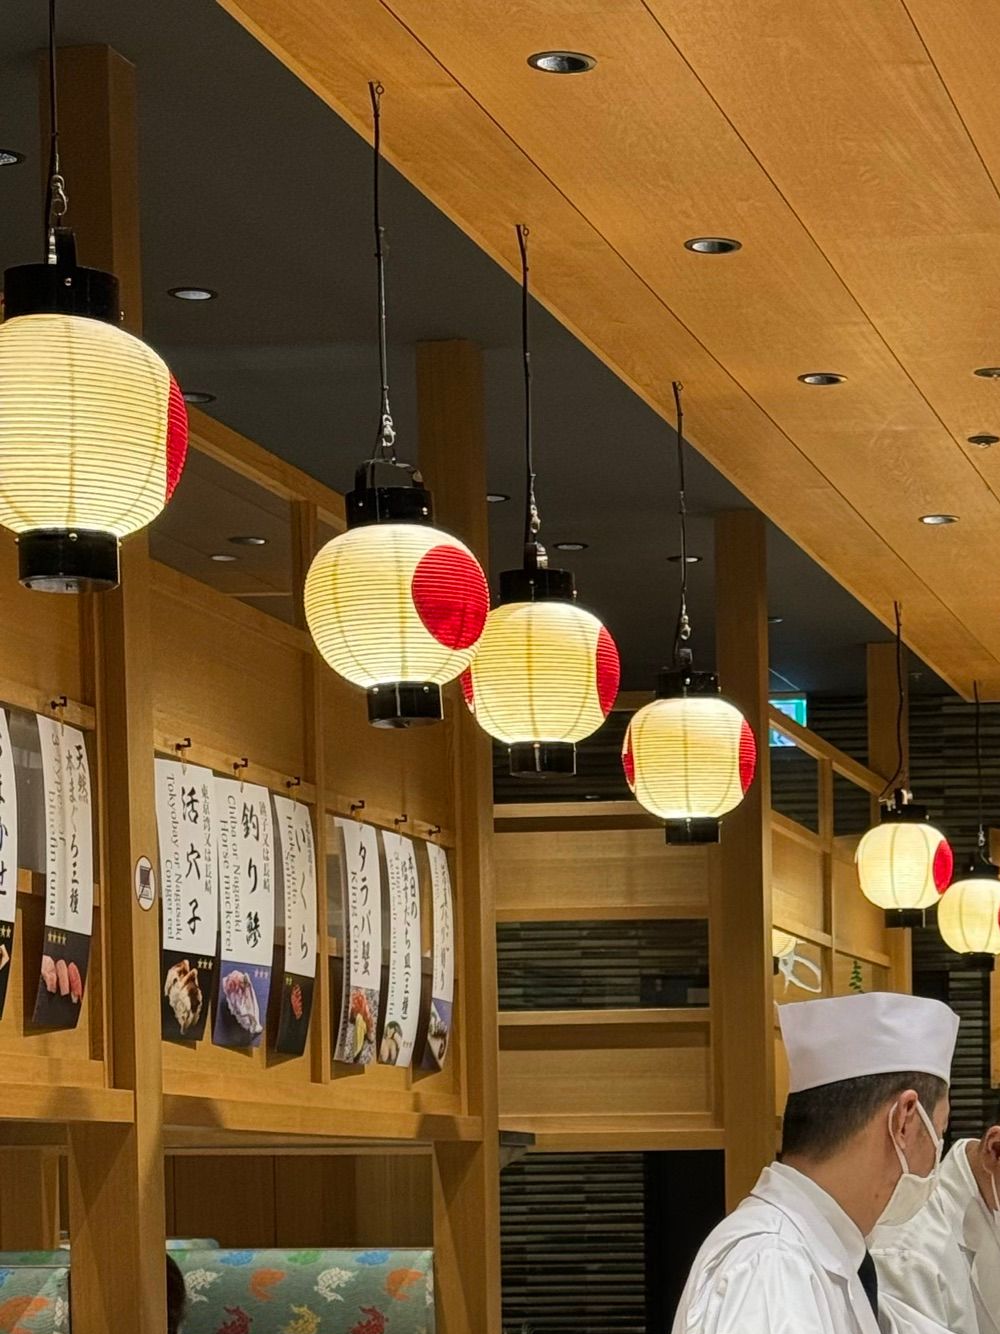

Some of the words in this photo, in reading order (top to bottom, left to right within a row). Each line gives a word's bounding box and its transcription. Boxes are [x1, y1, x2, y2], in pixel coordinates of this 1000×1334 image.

[220, 819, 230, 870] Horse
[227, 794, 238, 839] Chiba
[165, 859, 173, 914] Conger
[166, 774, 180, 848] Tokyobay
[174, 872, 183, 941] Nagasaki
[181, 785, 202, 935] 活穴子
[241, 801, 262, 949] 釣り鯵
[295, 828, 308, 960] いくら
[350, 871, 359, 918] King
[223, 874, 233, 953] mackerel
[232, 864, 242, 933] Nagasaki
